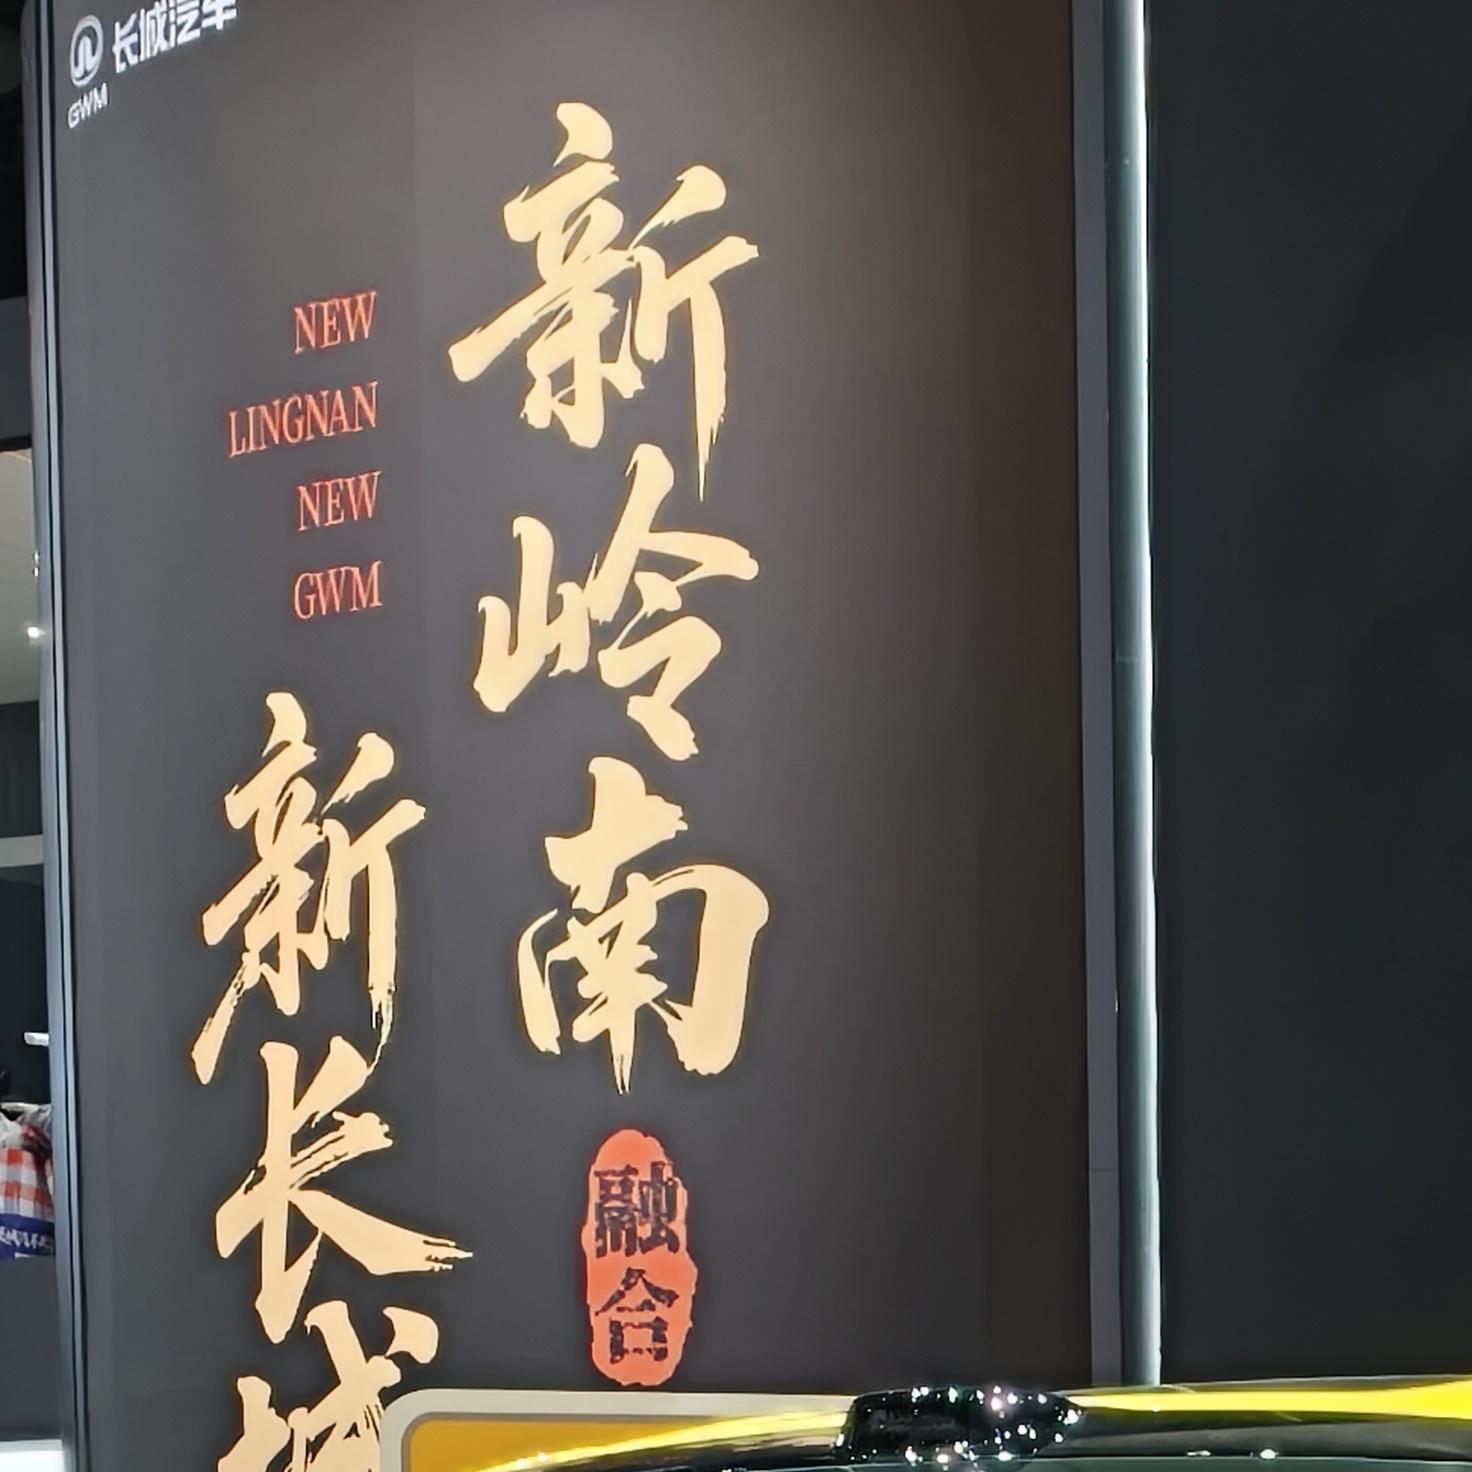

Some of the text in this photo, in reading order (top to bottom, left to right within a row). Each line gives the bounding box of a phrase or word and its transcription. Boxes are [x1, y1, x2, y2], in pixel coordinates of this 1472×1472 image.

[112, 0, 237, 73] 长城汽车
[68, 83, 108, 128] GWM
[294, 291, 377, 354] NEW
[228, 381, 378, 457] LINGNAN
[297, 471, 381, 531] NEW
[293, 561, 383, 619] GWM
[448, 102, 769, 1095] 新岭南
[593, 1160, 680, 1364] 融合
